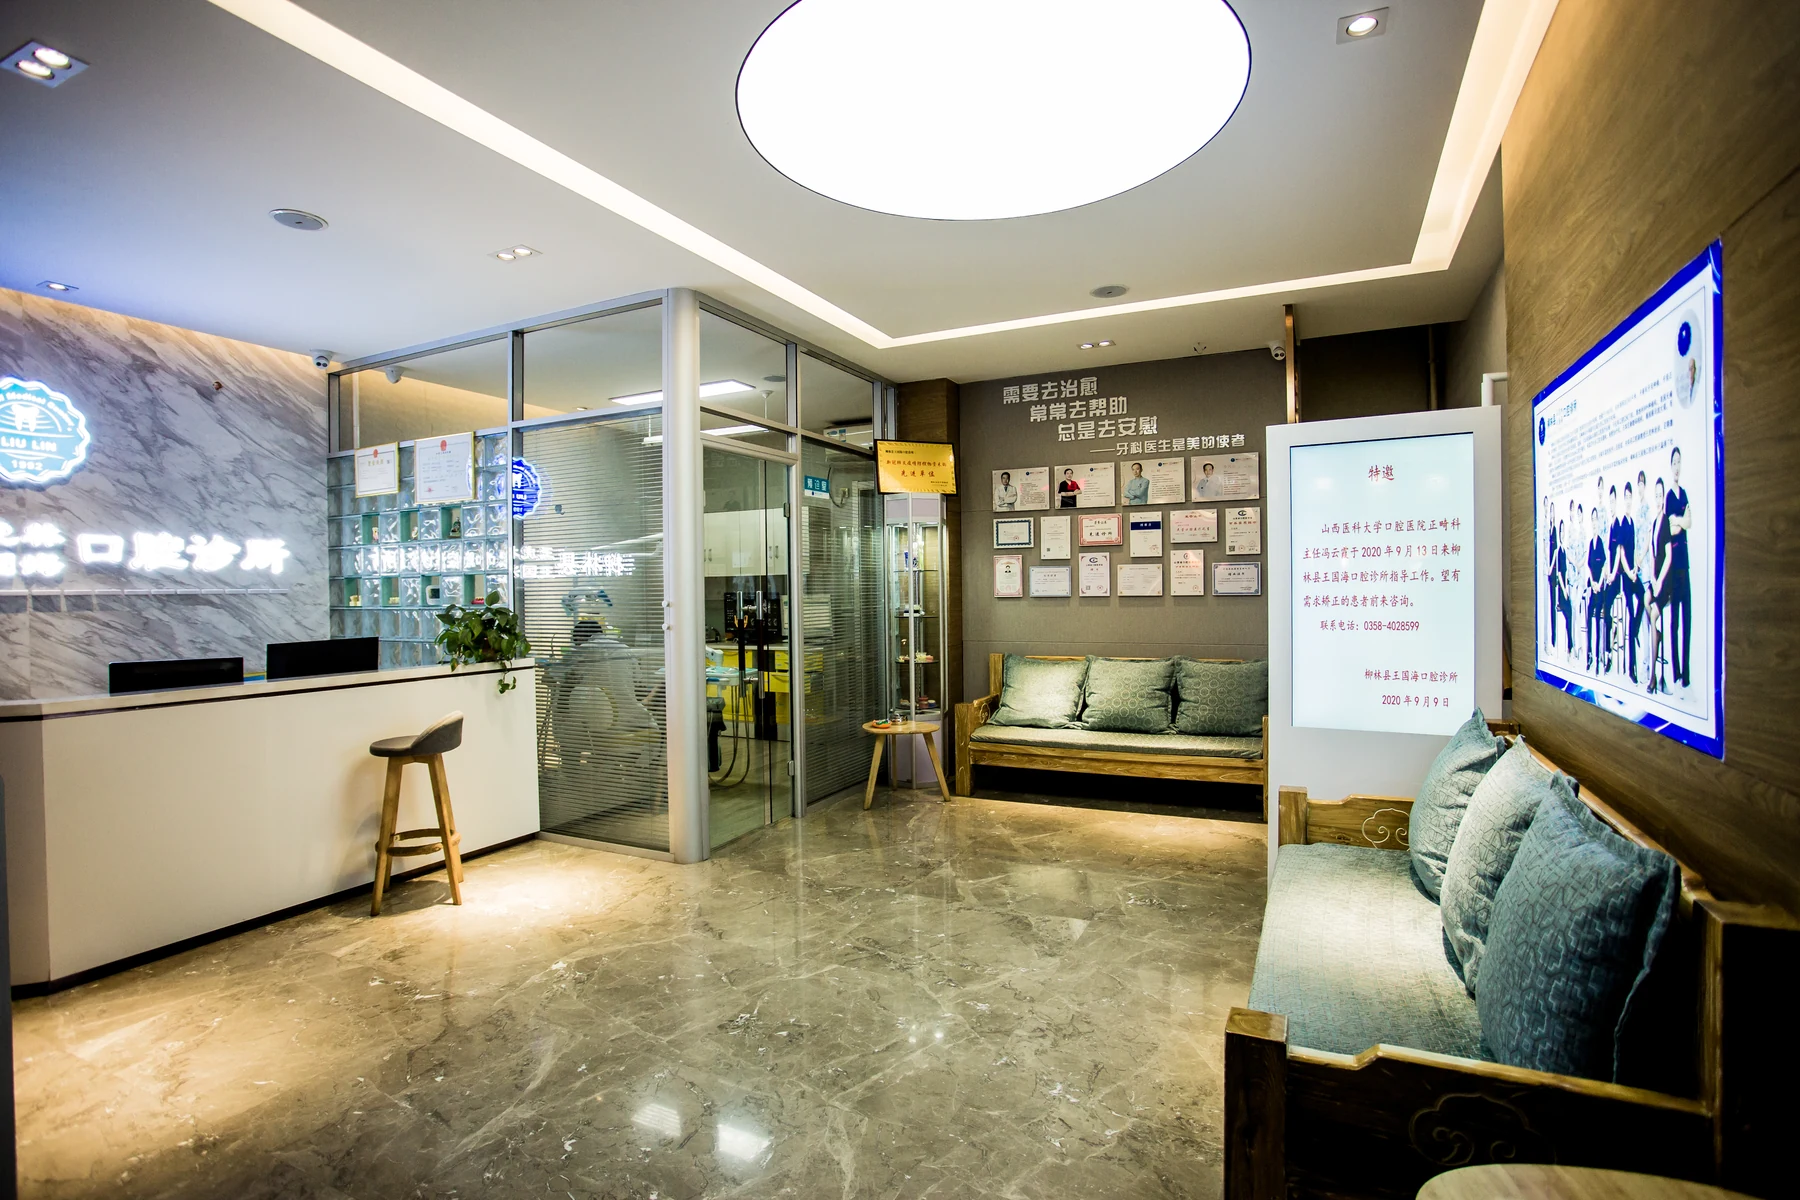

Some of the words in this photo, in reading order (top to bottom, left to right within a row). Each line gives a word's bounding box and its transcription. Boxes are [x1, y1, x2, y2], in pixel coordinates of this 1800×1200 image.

[1003, 376, 1098, 404] 需要去治愈
[1030, 395, 1128, 423] 常常去帮助
[1058, 415, 1158, 442] 总是去安慰
[1, 436, 27, 448] LIU
[32, 440, 57, 452] LIN
[1368, 464, 1395, 482] 特邀
[1321, 517, 1461, 534] 山西医科大学口腔医院正畸科
[1303, 595, 1414, 607] 需求矫正的患者前来咨询。
[1364, 668, 1458, 683] 柳林县王国海口腔诊所
